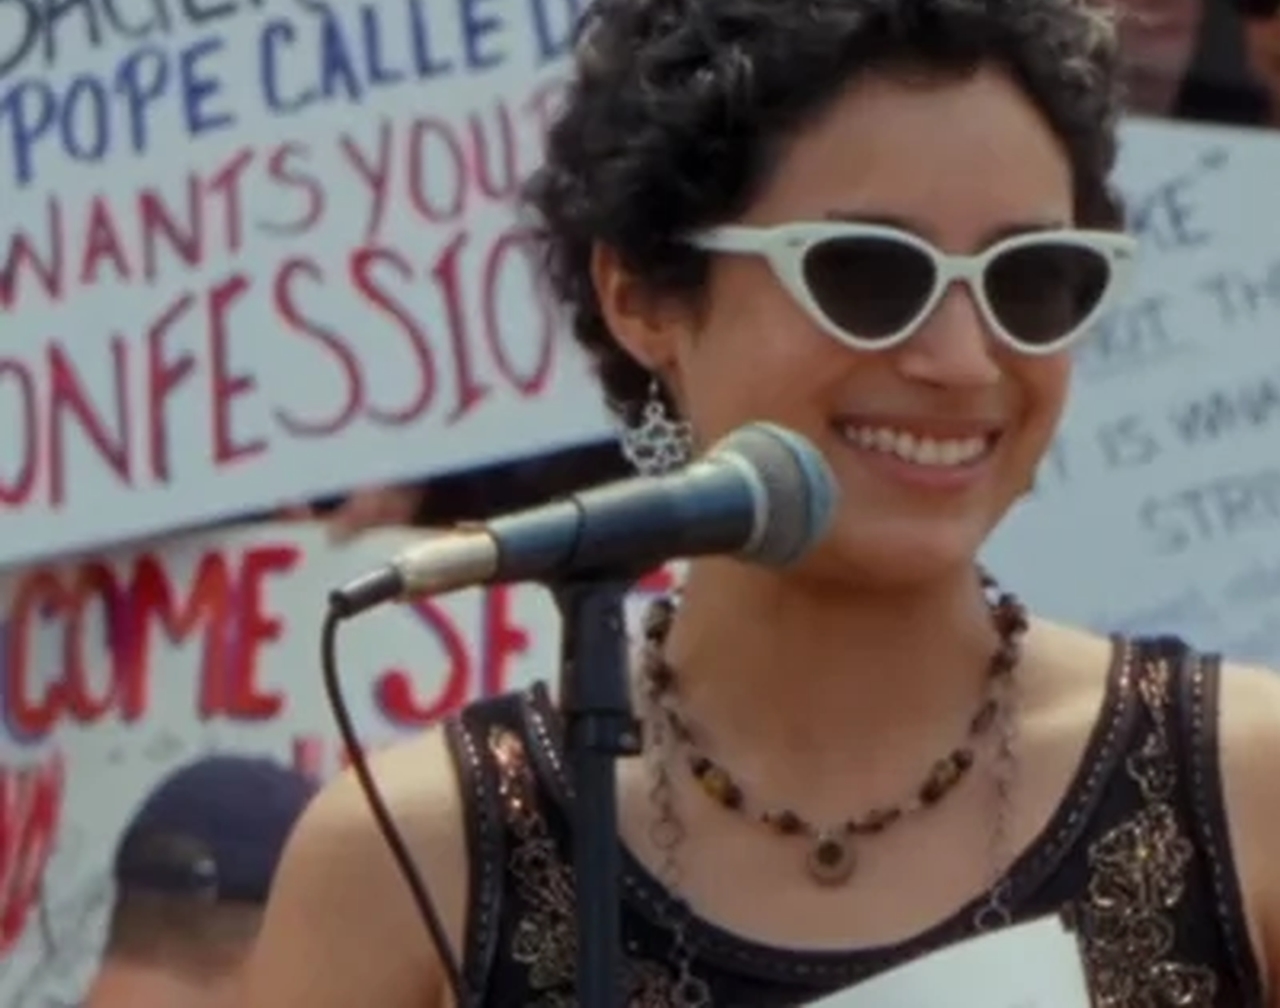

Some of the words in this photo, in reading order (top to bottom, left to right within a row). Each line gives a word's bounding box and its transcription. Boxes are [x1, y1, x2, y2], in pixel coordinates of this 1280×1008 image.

[0, 36, 236, 186] POPE
[0, 142, 325, 309] WANTS
[1098, 413, 1159, 470] IS
